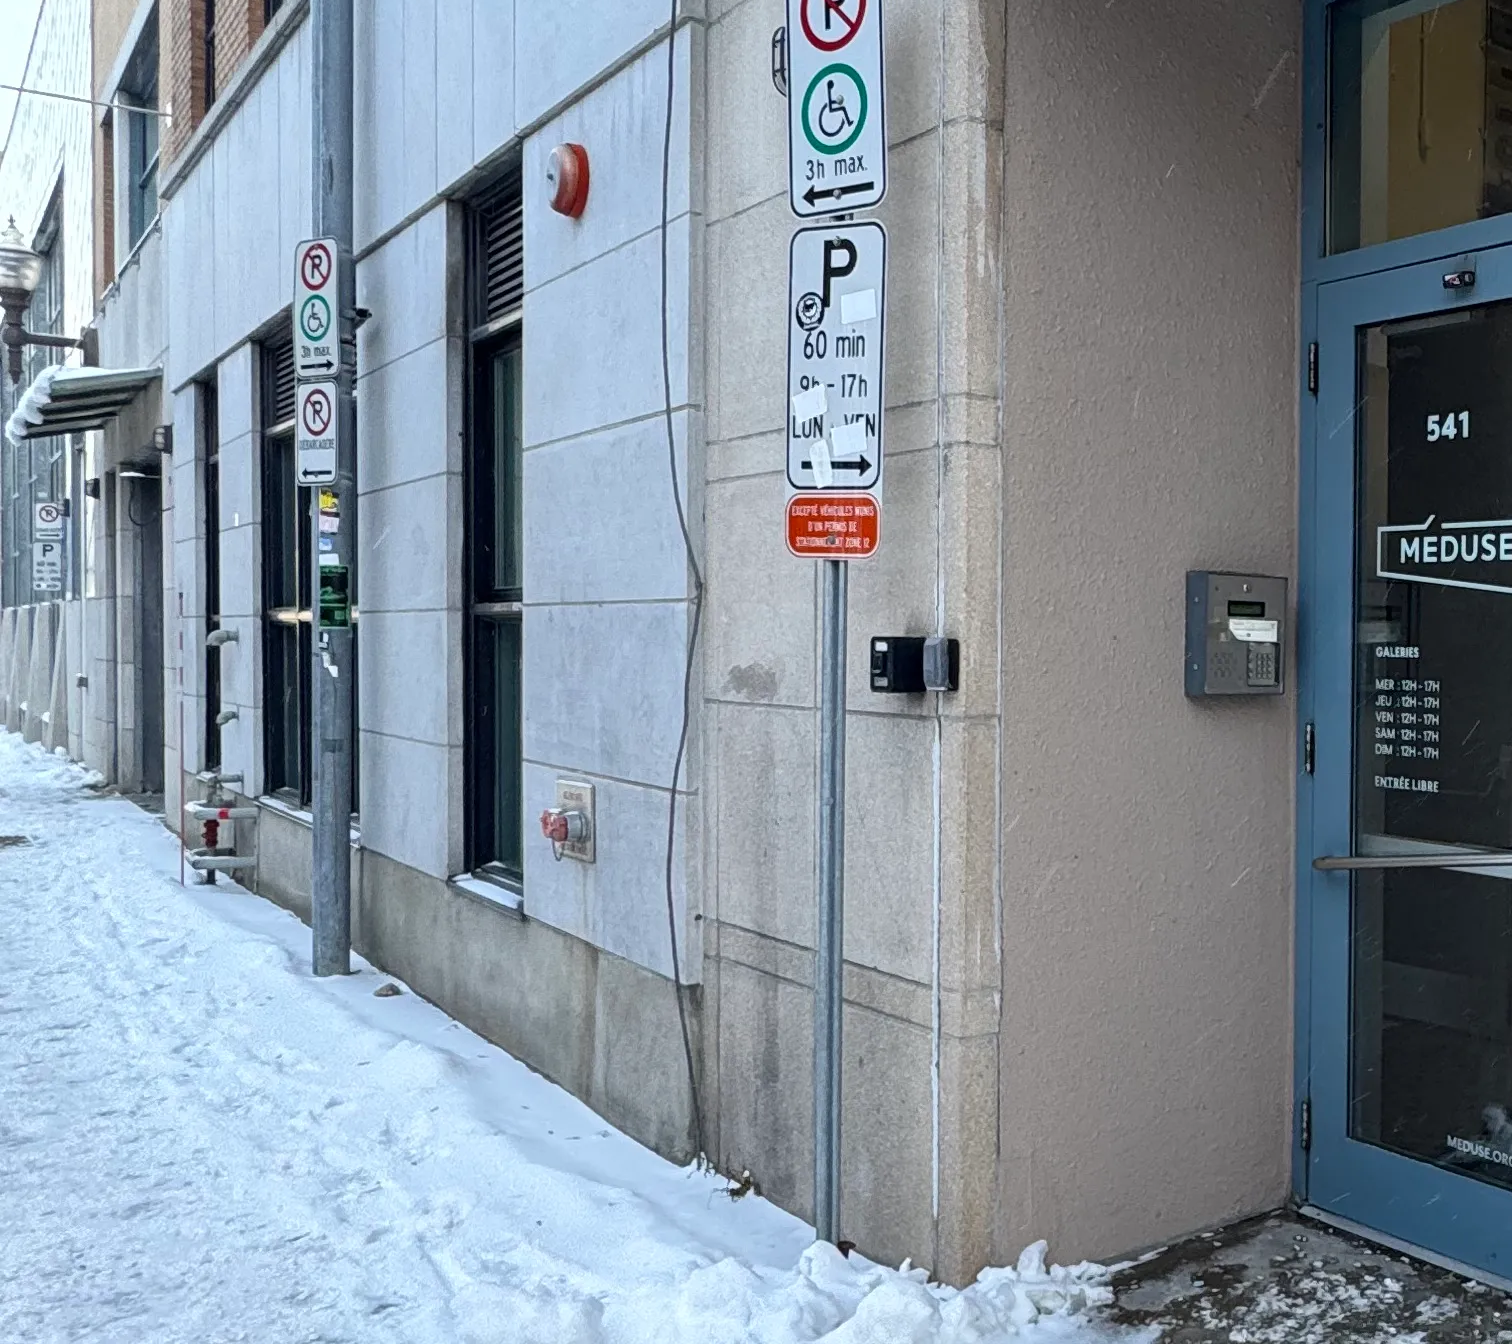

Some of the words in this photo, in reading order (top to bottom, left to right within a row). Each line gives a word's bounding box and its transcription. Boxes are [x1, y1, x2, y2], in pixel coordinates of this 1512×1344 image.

[805, 159, 825, 181] 3h
[834, 155, 868, 177] max.
[823, 238, 857, 307] P
[804, 330, 827, 360] 60
[836, 329, 865, 358] min
[841, 374, 867, 398] 17h
[793, 414, 823, 438] LUN
[1426, 410, 1470, 442] 541
[1375, 646, 1420, 658] GALERIES
[1401, 679, 1417, 691] 12H
[1424, 680, 1440, 692] 17H
[1401, 696, 1417, 707] 12H
[1423, 697, 1440, 709] 17H
[1401, 712, 1417, 724] 12H
[1423, 713, 1440, 726] 17H
[1401, 729, 1417, 741] 12H
[1423, 730, 1440, 742] 17H
[1400, 745, 1417, 757] 12H
[1422, 747, 1440, 760] 17H
[1374, 775, 1410, 790] ENTRÉE
[1412, 779, 1440, 793] LIBRE
